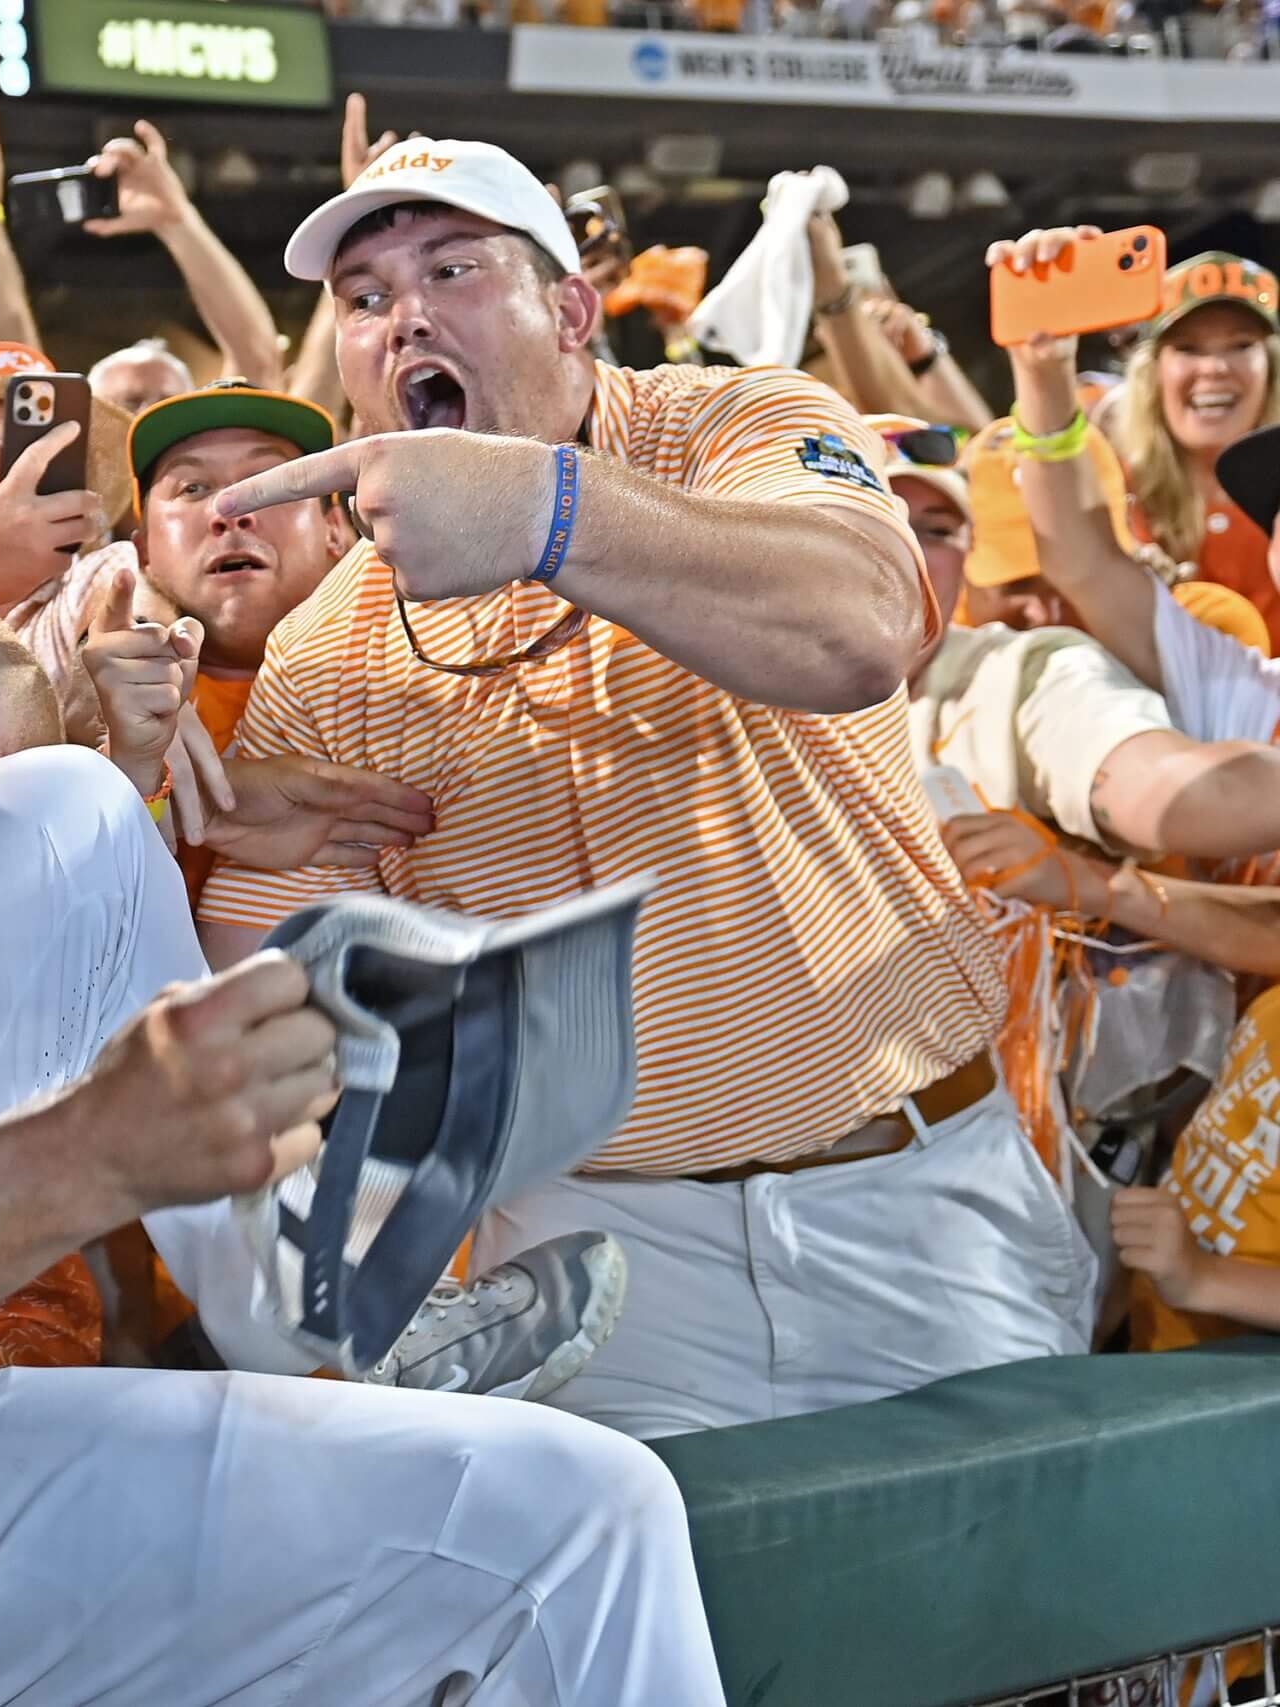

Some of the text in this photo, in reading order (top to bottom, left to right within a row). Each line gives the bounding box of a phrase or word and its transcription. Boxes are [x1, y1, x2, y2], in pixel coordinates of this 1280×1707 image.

[97, 18, 279, 83] #MCWS
[677, 47, 756, 81] MEN'S
[768, 51, 869, 84] COLLEGE
